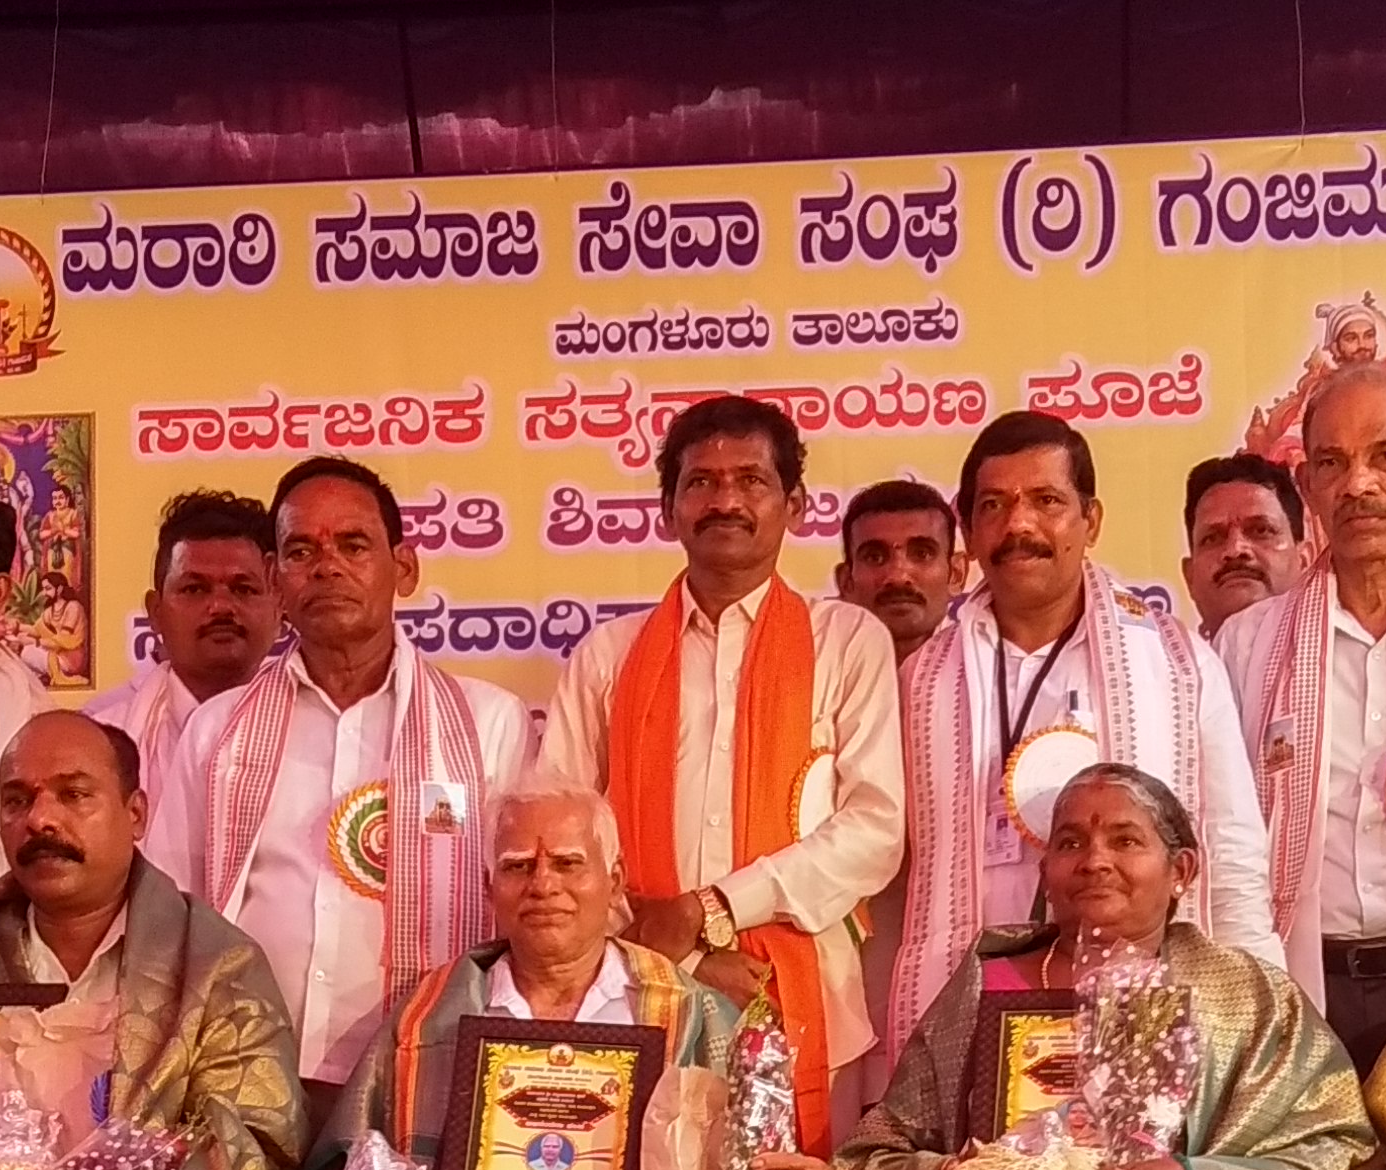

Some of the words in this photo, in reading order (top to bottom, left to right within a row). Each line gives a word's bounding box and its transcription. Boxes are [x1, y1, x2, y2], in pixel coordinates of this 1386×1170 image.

[61, 203, 275, 292] ಮರಾಠಿ
[315, 191, 539, 283] ಸಮಾಜ
[579, 181, 759, 273] ಸೇವಾ
[800, 164, 958, 273] ಸಂಘ
[1001, 155, 1116, 272] (ರಿ)
[555, 305, 770, 355] ಮಂಗಳೂರು
[793, 298, 959, 346] ತಾಲೂಕು
[138, 382, 485, 454] ಸಾರ್ವಜನಿಕ
[1028, 354, 1203, 420] ಪೂಜೆ
